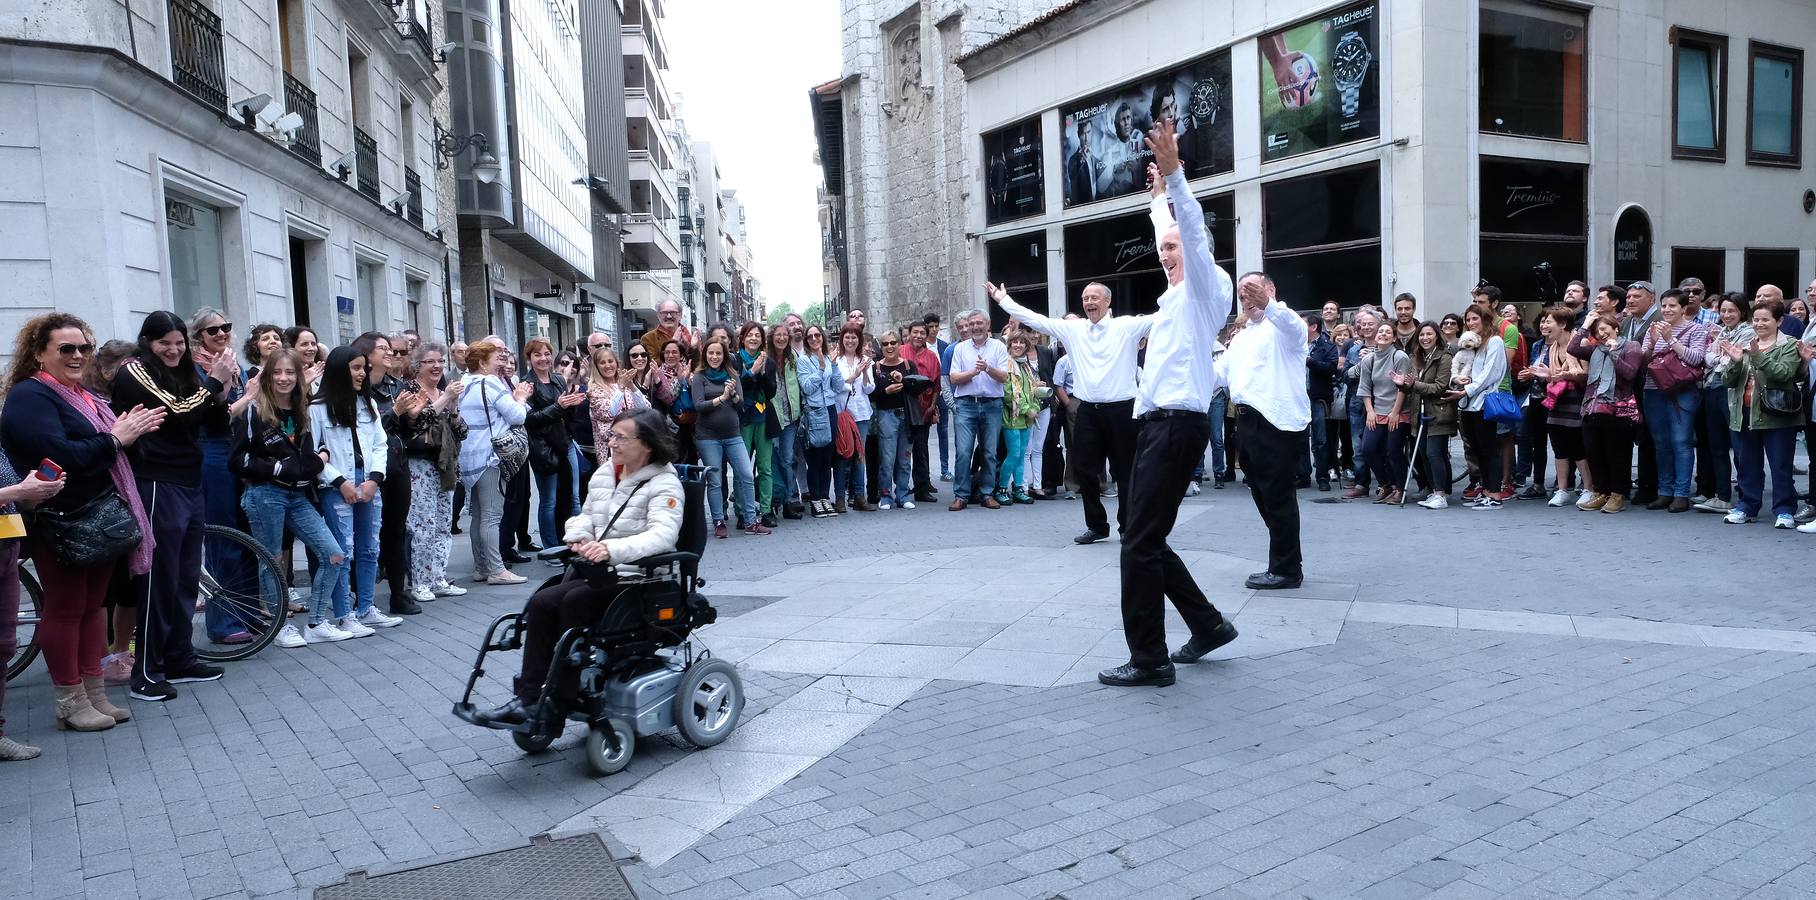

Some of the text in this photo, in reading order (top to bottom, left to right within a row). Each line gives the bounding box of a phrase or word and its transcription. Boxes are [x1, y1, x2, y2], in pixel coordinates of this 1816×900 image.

[1618, 240, 1638, 250] MONT
[1115, 237, 1157, 268] Tremi
[1618, 250, 1639, 261] BLANC
